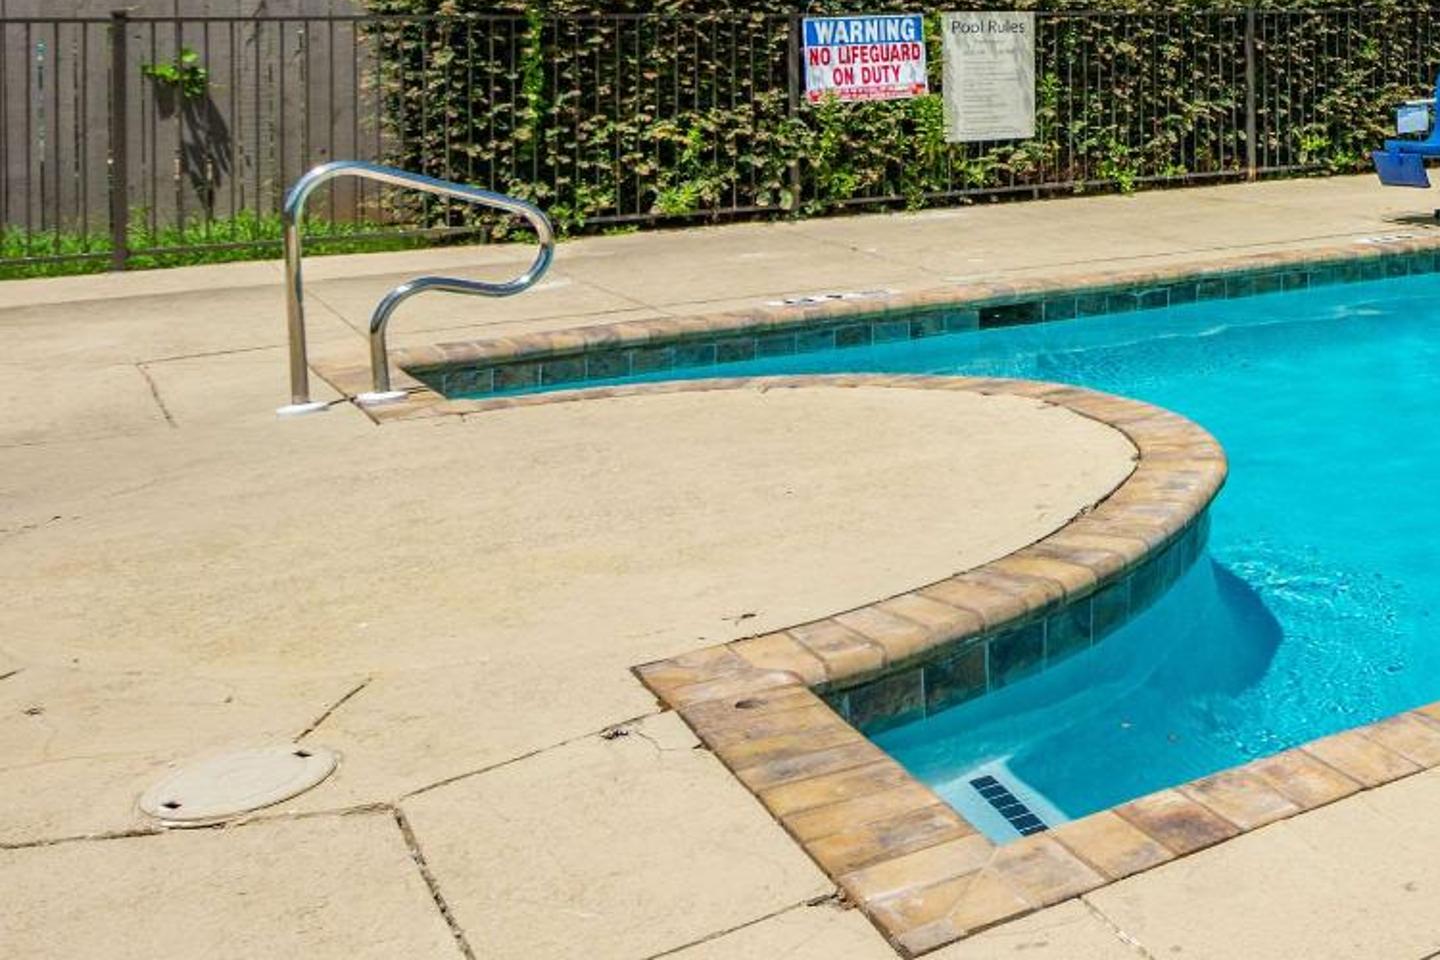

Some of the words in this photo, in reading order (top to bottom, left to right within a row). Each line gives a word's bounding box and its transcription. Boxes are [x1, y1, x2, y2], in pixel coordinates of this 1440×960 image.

[814, 19, 915, 43] WARNING
[951, 20, 984, 34] Pool
[988, 19, 1025, 34] Rules
[809, 46, 831, 66] NO
[838, 42, 921, 64] LIFEGUARD
[832, 67, 855, 86] ON
[861, 64, 900, 84] DUTY
